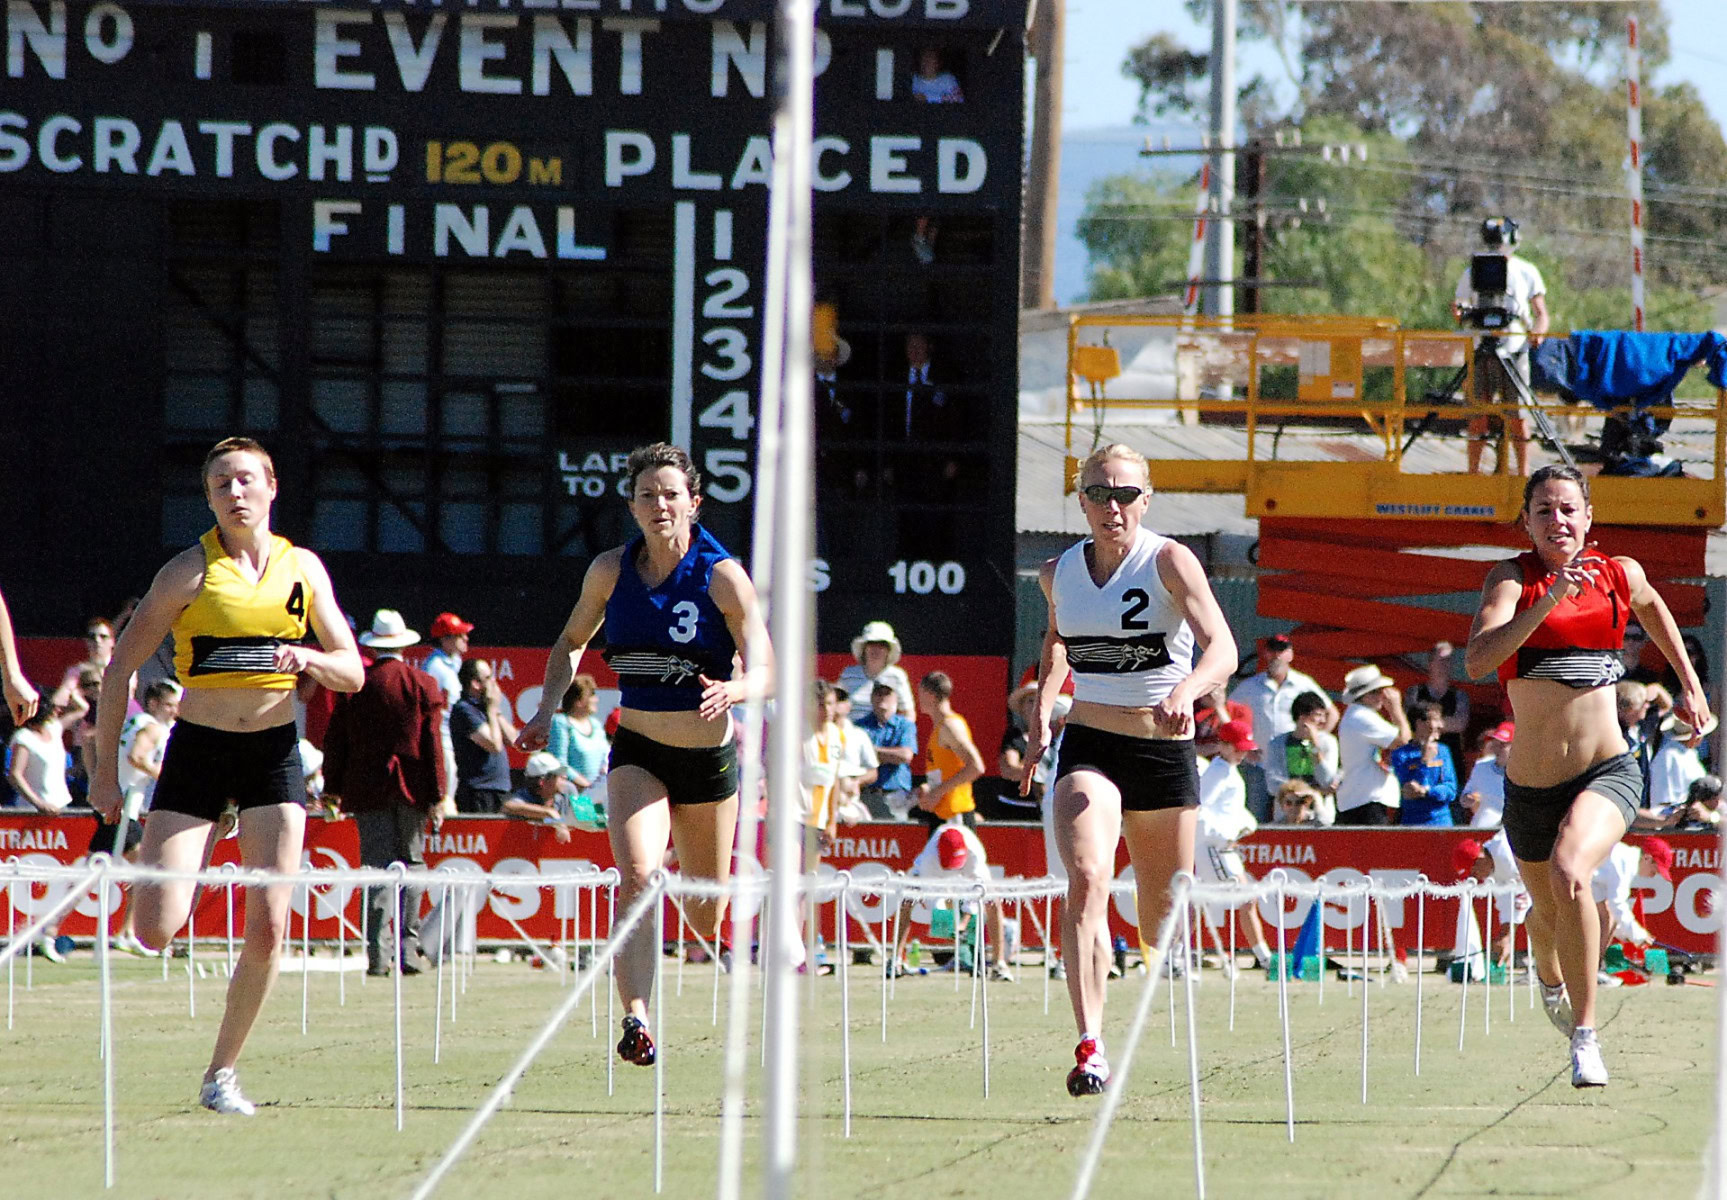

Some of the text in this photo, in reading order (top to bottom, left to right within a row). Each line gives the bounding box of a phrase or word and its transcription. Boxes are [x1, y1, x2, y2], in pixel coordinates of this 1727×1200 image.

[314, 9, 661, 96] EVENT
[604, 129, 988, 193] PLACED
[313, 201, 607, 260] FINAL
[702, 268, 754, 319] 2
[701, 327, 752, 381] 3
[699, 390, 754, 440] 4
[562, 476, 606, 497] TO
[705, 450, 752, 504] 5
[285, 582, 304, 623] 4
[888, 560, 965, 595] 100
[669, 601, 699, 643] 3
[1121, 588, 1149, 630] 2
[1608, 589, 1619, 629] 1
